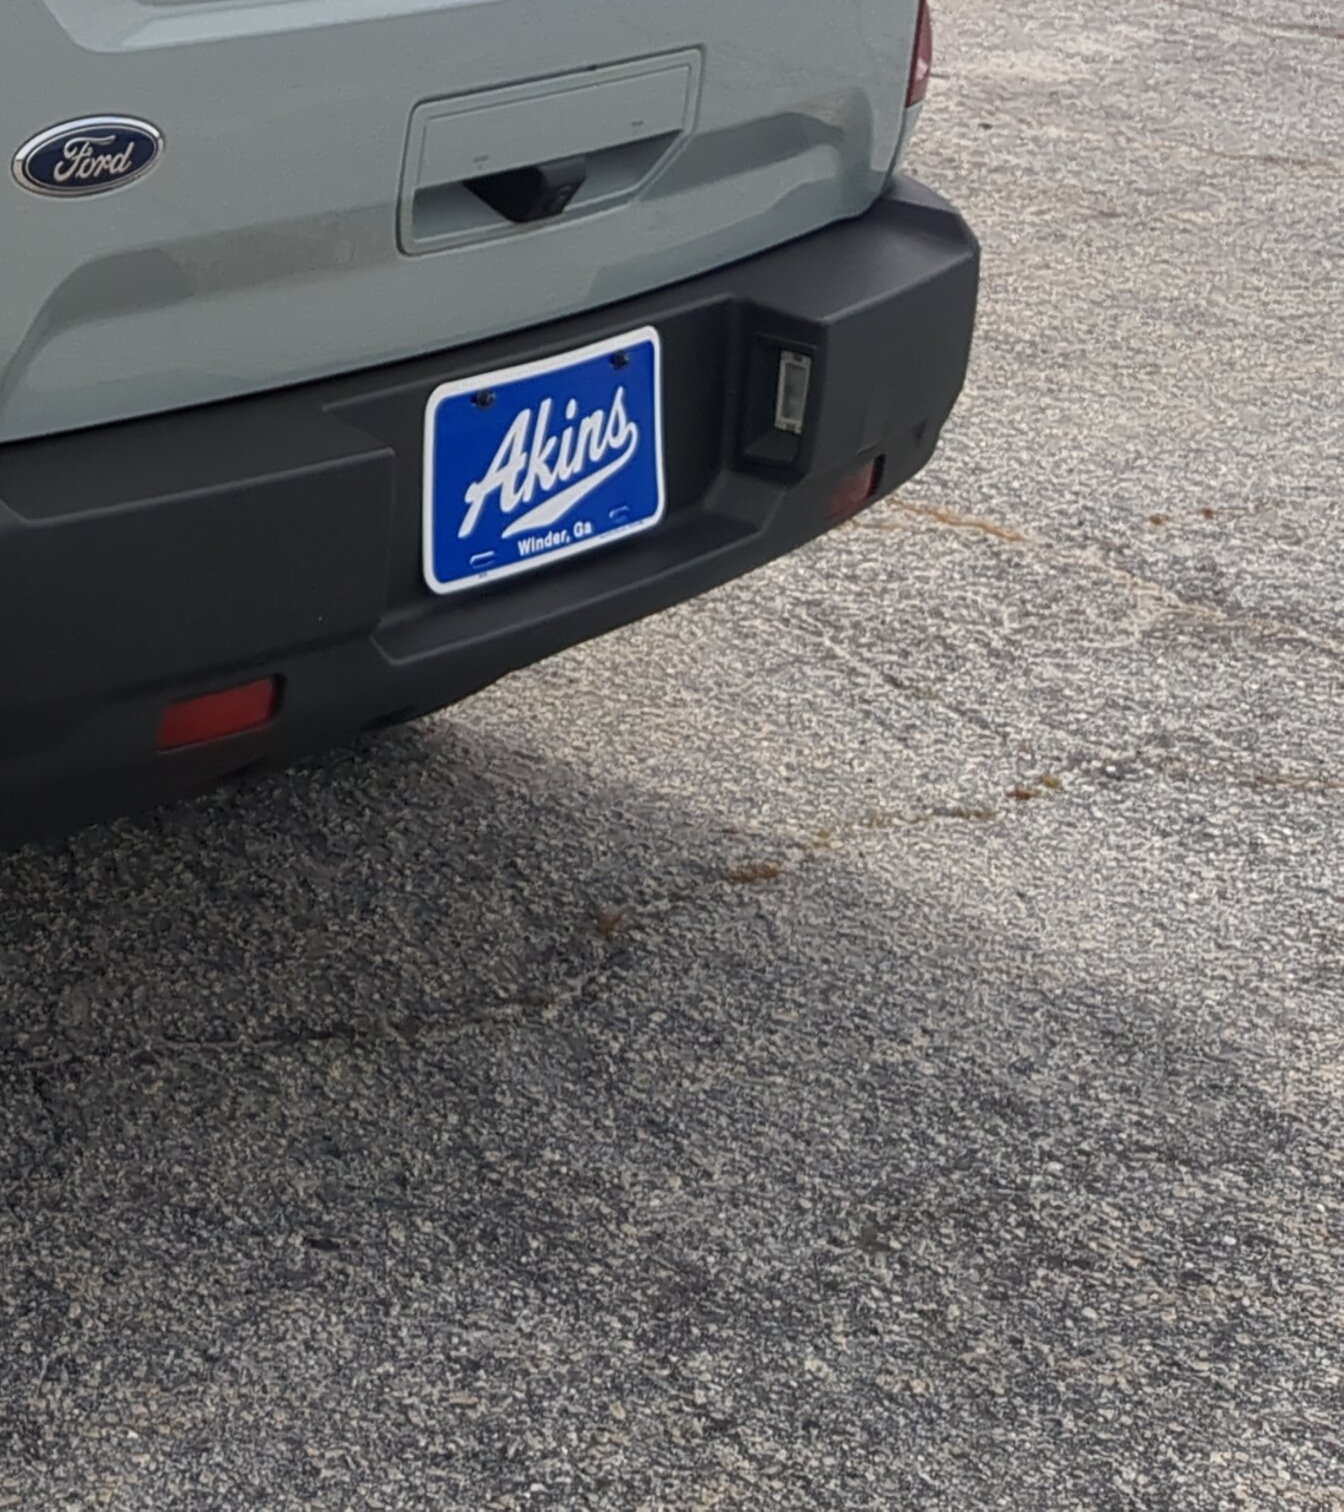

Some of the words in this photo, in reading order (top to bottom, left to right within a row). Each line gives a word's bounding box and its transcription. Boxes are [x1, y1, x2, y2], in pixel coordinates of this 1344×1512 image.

[53, 134, 134, 182] Ford
[458, 385, 638, 538] Akins
[518, 530, 570, 556] Winder,
[573, 521, 592, 538] Ga
